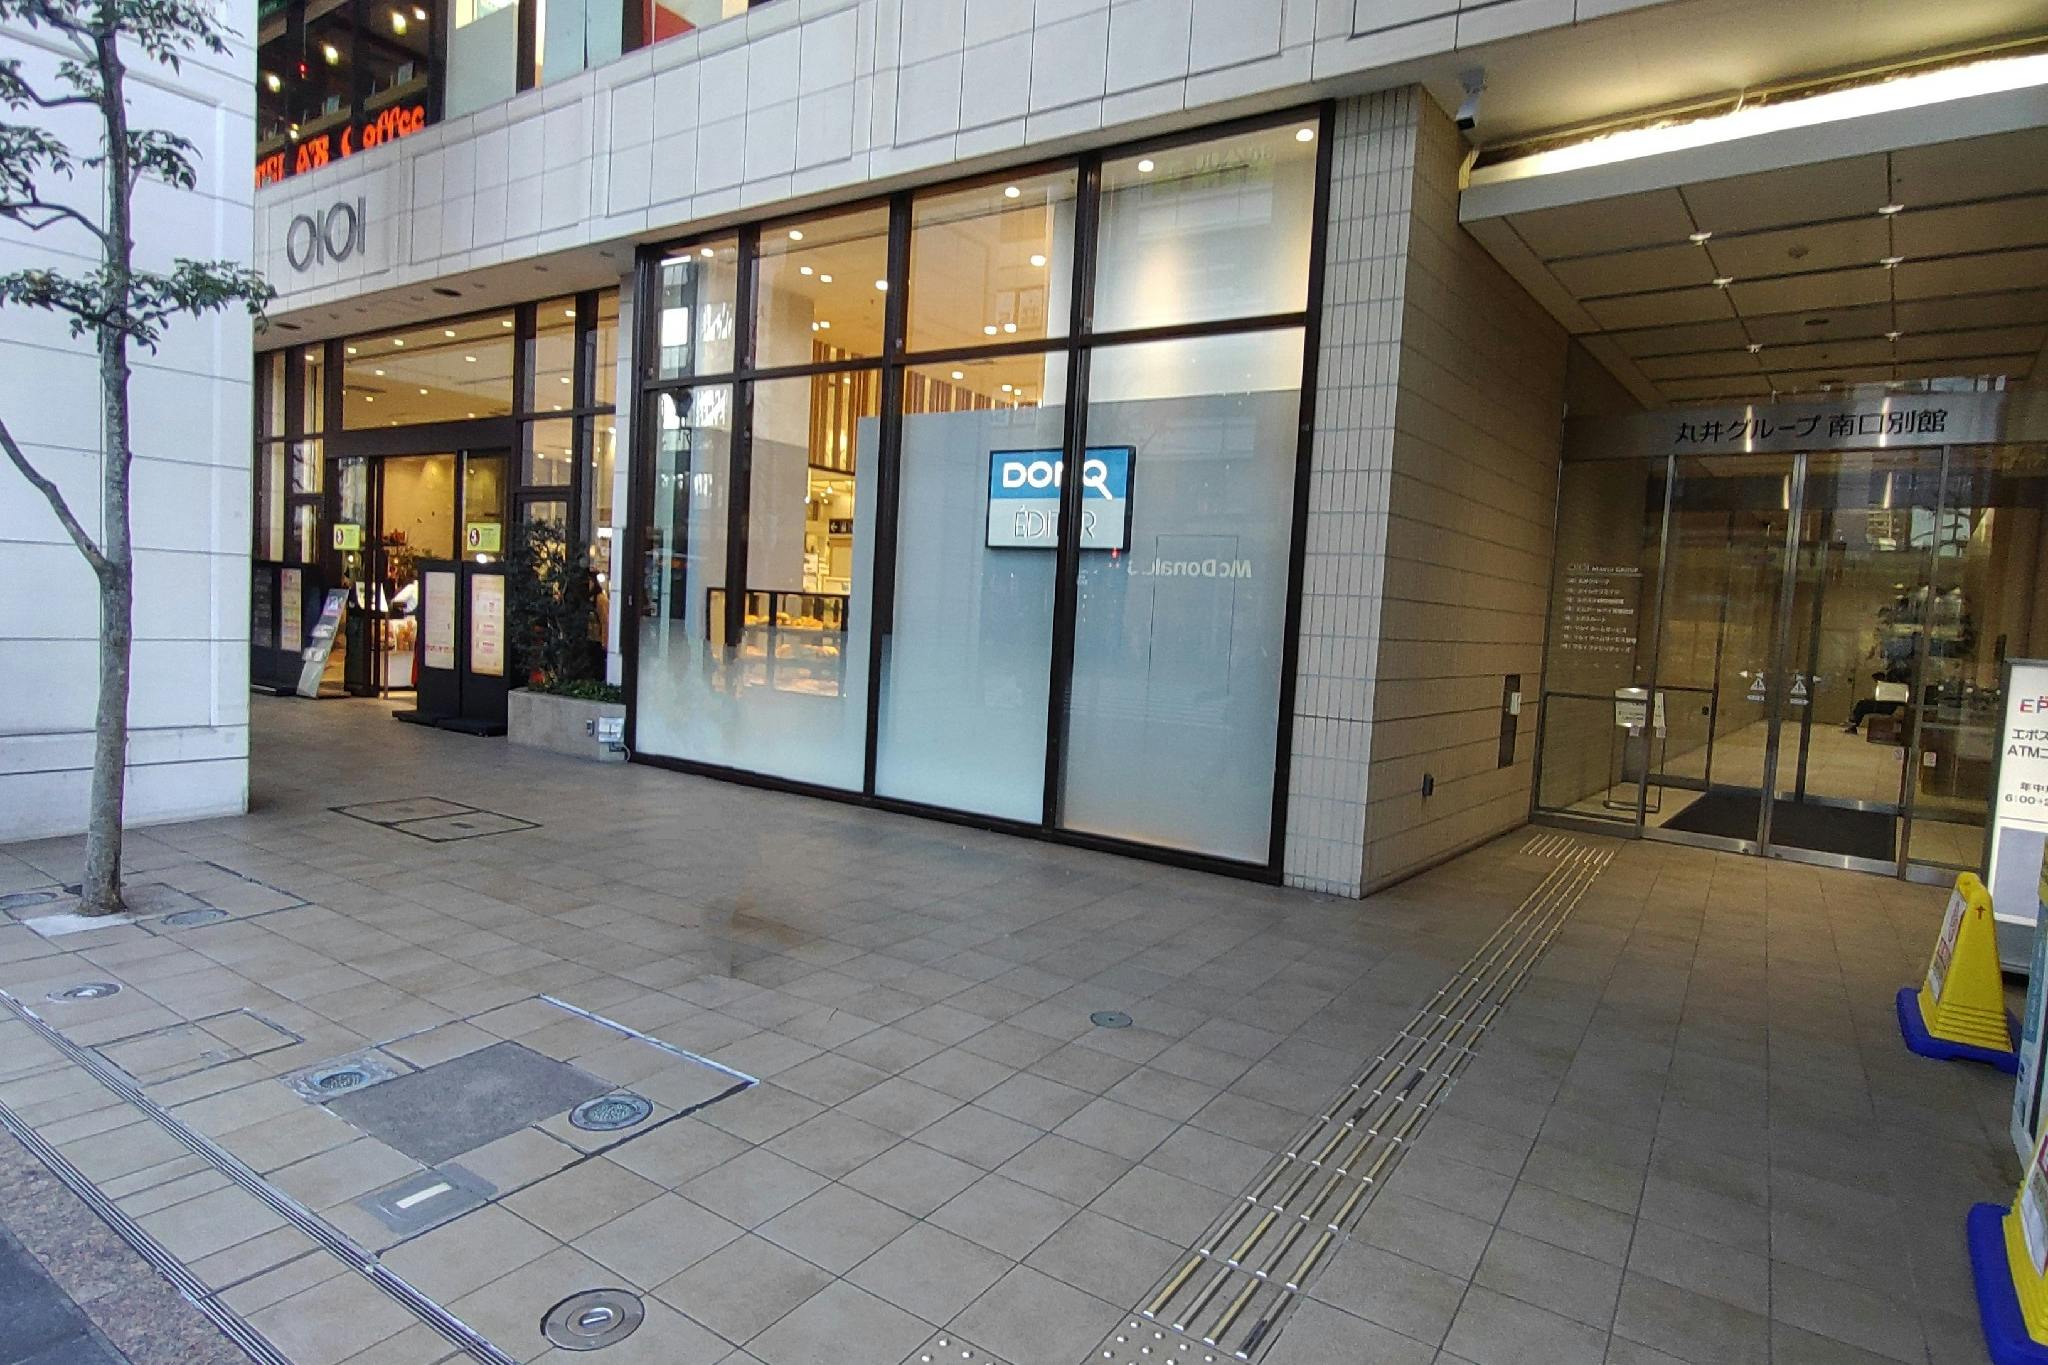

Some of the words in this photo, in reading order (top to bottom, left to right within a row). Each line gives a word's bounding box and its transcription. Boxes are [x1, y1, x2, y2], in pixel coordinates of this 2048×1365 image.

[1675, 414, 1822, 444] 丸井グループ
[1828, 408, 1948, 438] 南口別館
[2020, 781, 2048, 792] 年中
